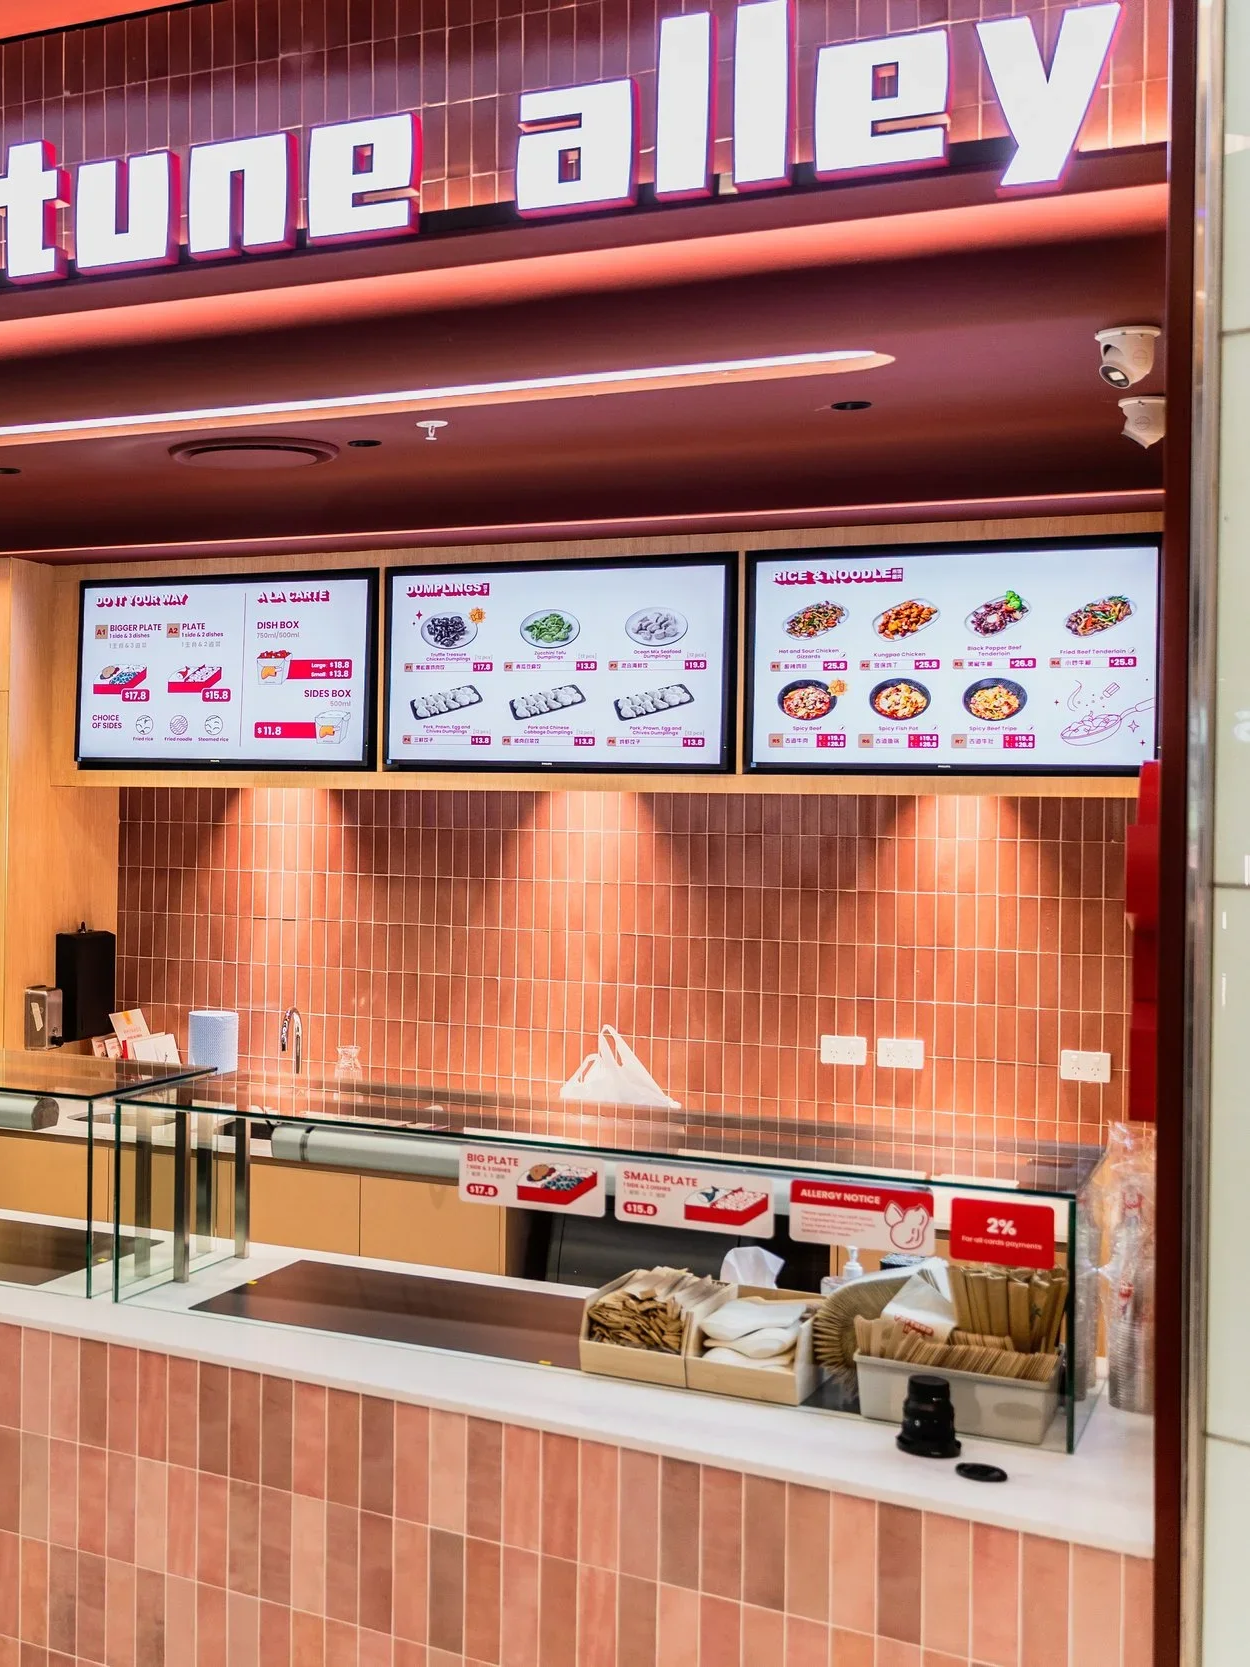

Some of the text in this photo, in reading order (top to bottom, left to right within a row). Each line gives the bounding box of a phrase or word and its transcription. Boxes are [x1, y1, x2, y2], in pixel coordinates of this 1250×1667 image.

[516, 0, 1123, 216] alley
[774, 571, 811, 585] RICE
[812, 570, 824, 582] &
[826, 569, 891, 583] NOODLE
[258, 590, 330, 603] A LA CARTE
[406, 583, 482, 597] DUMPLINGS
[96, 594, 188, 608] DO IT YOUR WAY
[124, 691, 147, 700] $17.8
[205, 691, 228, 699] $15.8
[467, 1153, 518, 1166] BIG PLATE
[624, 1171, 698, 1187] SMALL PLATE
[469, 1185, 495, 1196] $17.8
[800, 1188, 881, 1204] ALLERGY NOTICE
[626, 1203, 654, 1214] $15.8
[986, 1217, 1017, 1236] 2%
[1005, 1240, 1042, 1250] payments
